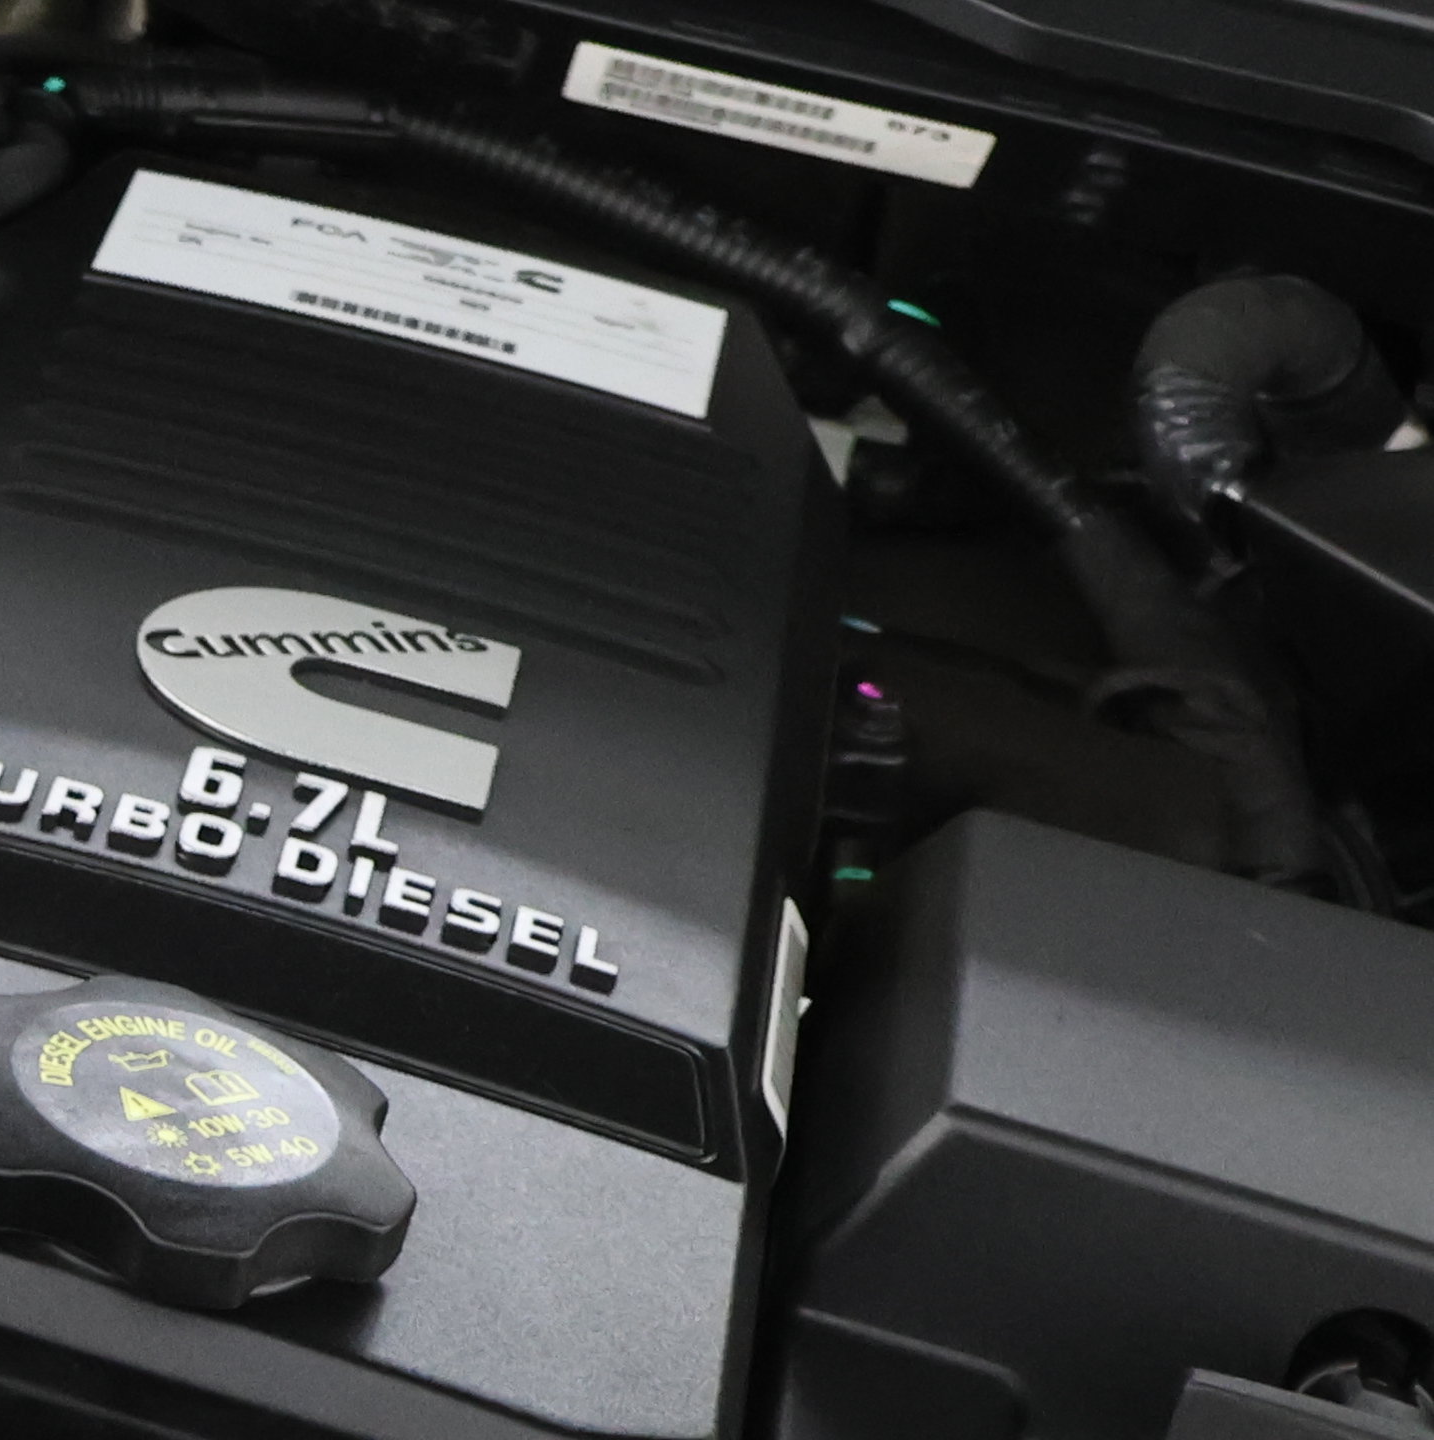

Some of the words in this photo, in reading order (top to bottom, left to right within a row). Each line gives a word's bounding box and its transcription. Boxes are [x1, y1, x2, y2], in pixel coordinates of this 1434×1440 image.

[145, 621, 489, 659] Cummins
[177, 746, 399, 862] 6.7L
[273, 838, 618, 988] DIESEL
[38, 1030, 92, 1087] DIESEL
[77, 1015, 187, 1042] ENGINE
[194, 1028, 238, 1059] OIL
